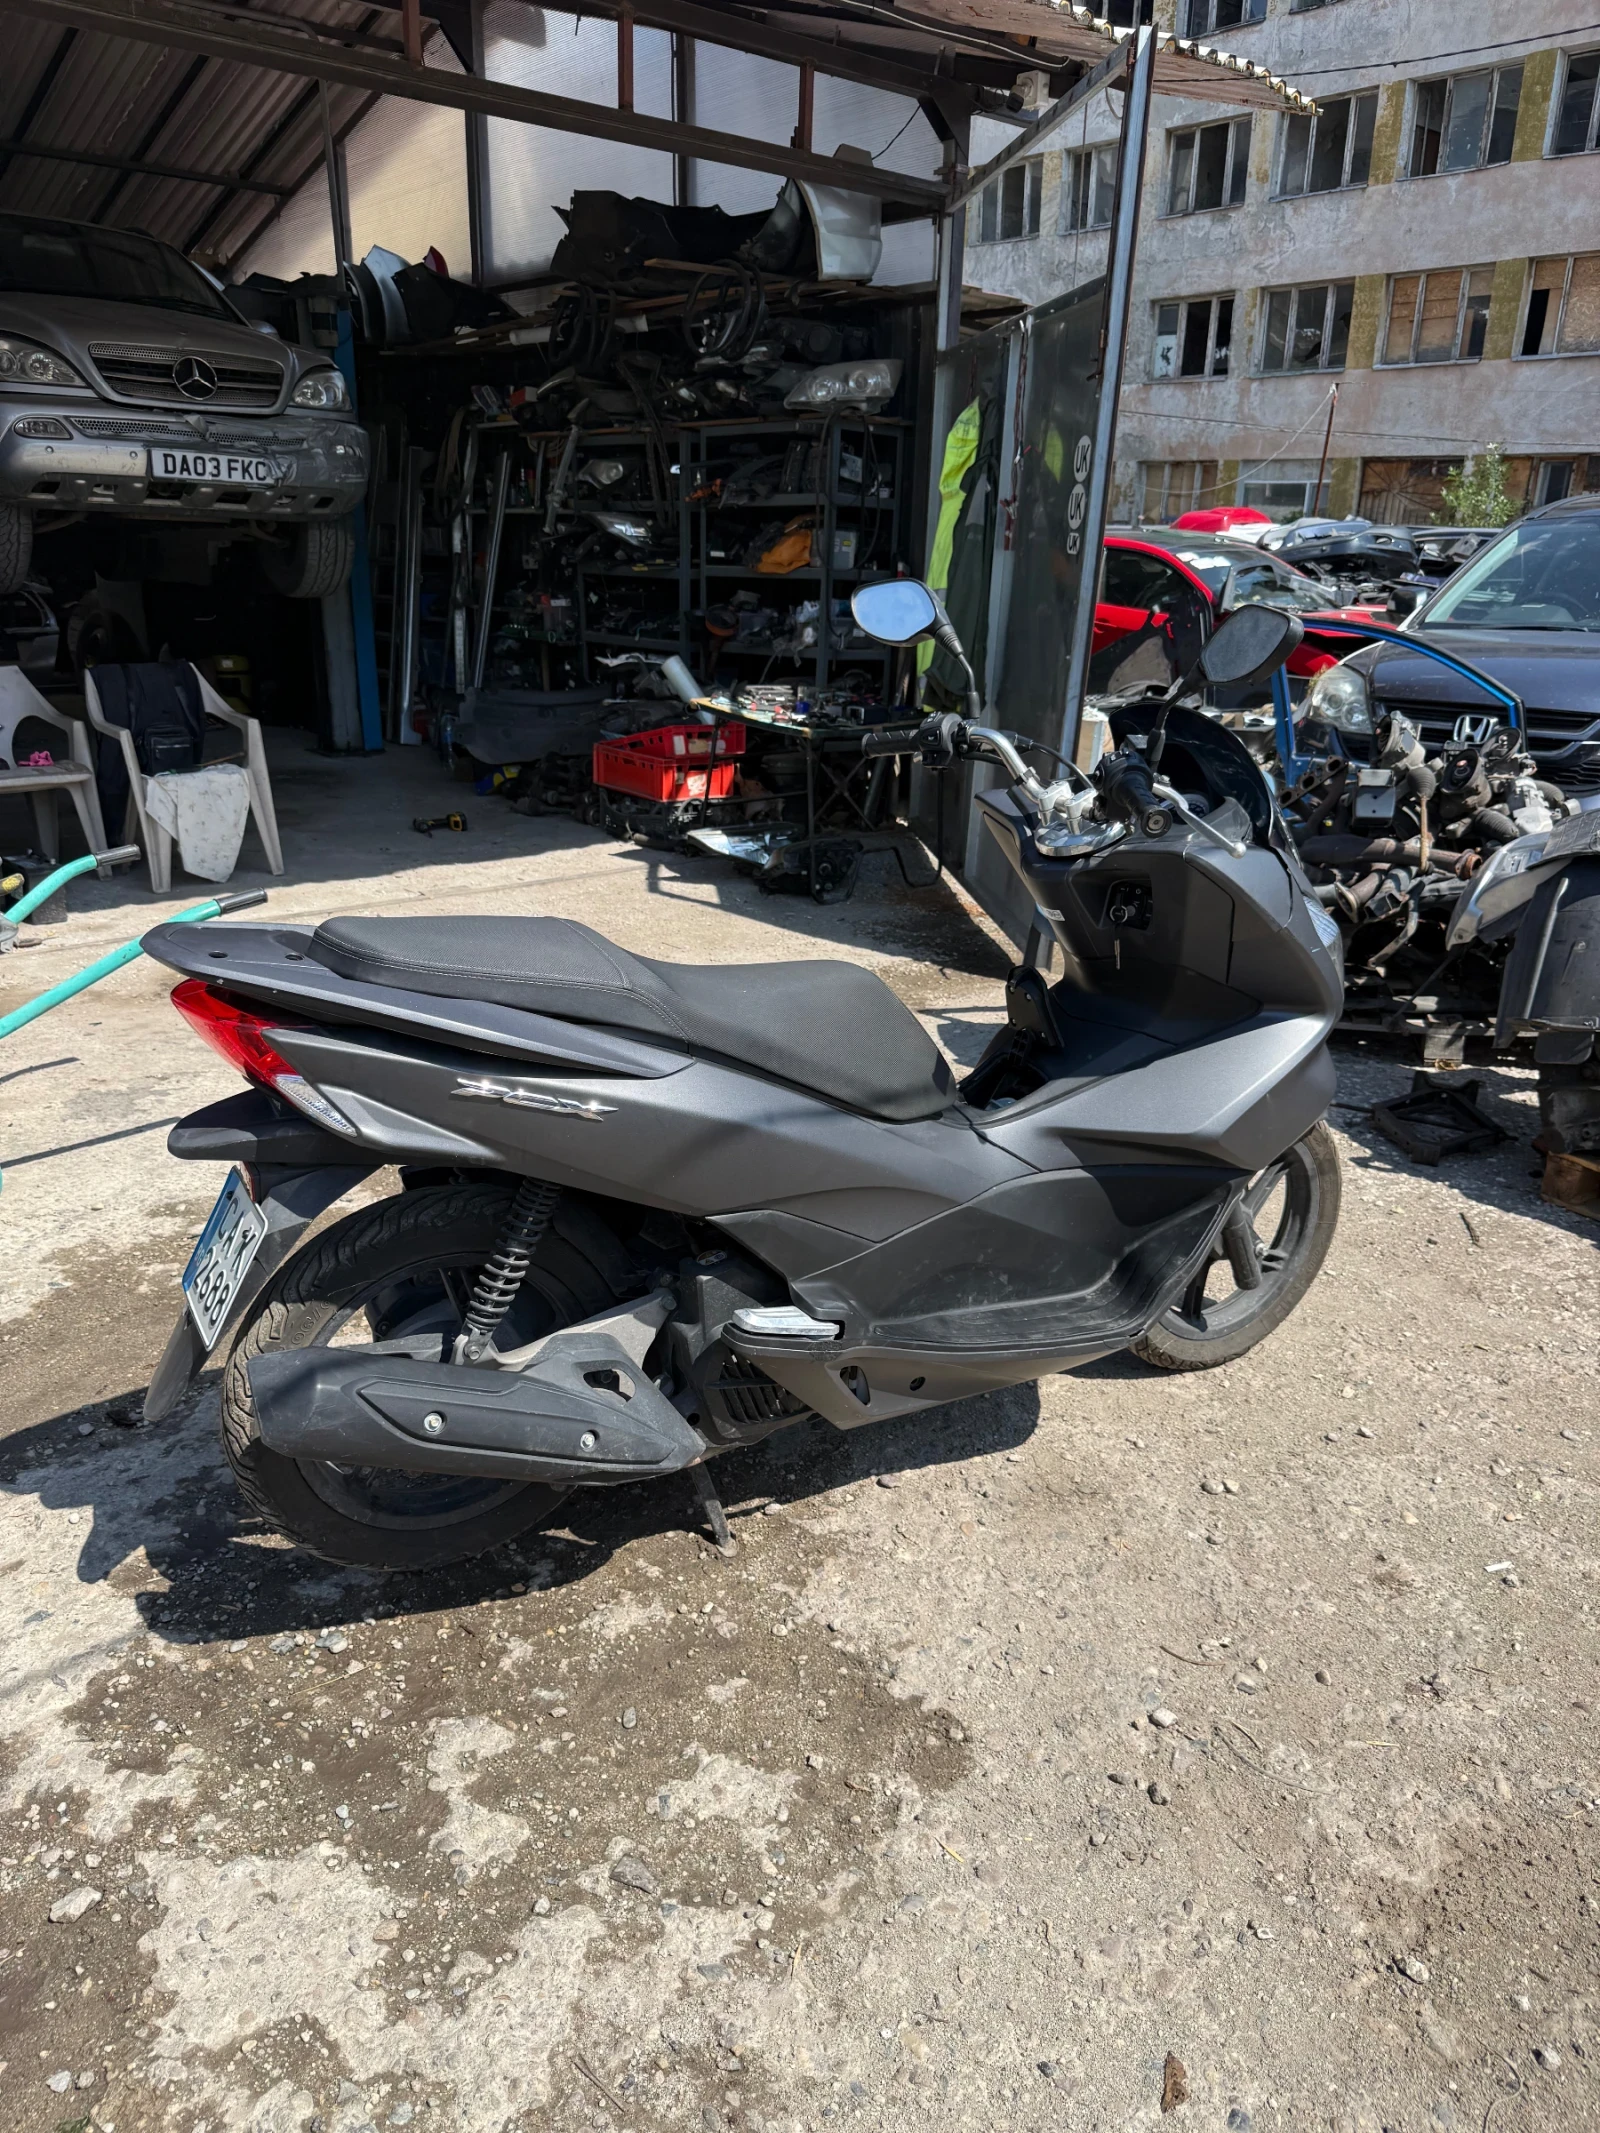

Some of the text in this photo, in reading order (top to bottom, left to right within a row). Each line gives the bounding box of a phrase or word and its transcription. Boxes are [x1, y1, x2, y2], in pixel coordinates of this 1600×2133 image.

[163, 453, 267, 481] DA03 FKC
[1076, 444, 1091, 473] UK
[1069, 493, 1084, 520] UK
[1068, 534, 1079, 550] UK
[194, 1247, 230, 1327] 2688
